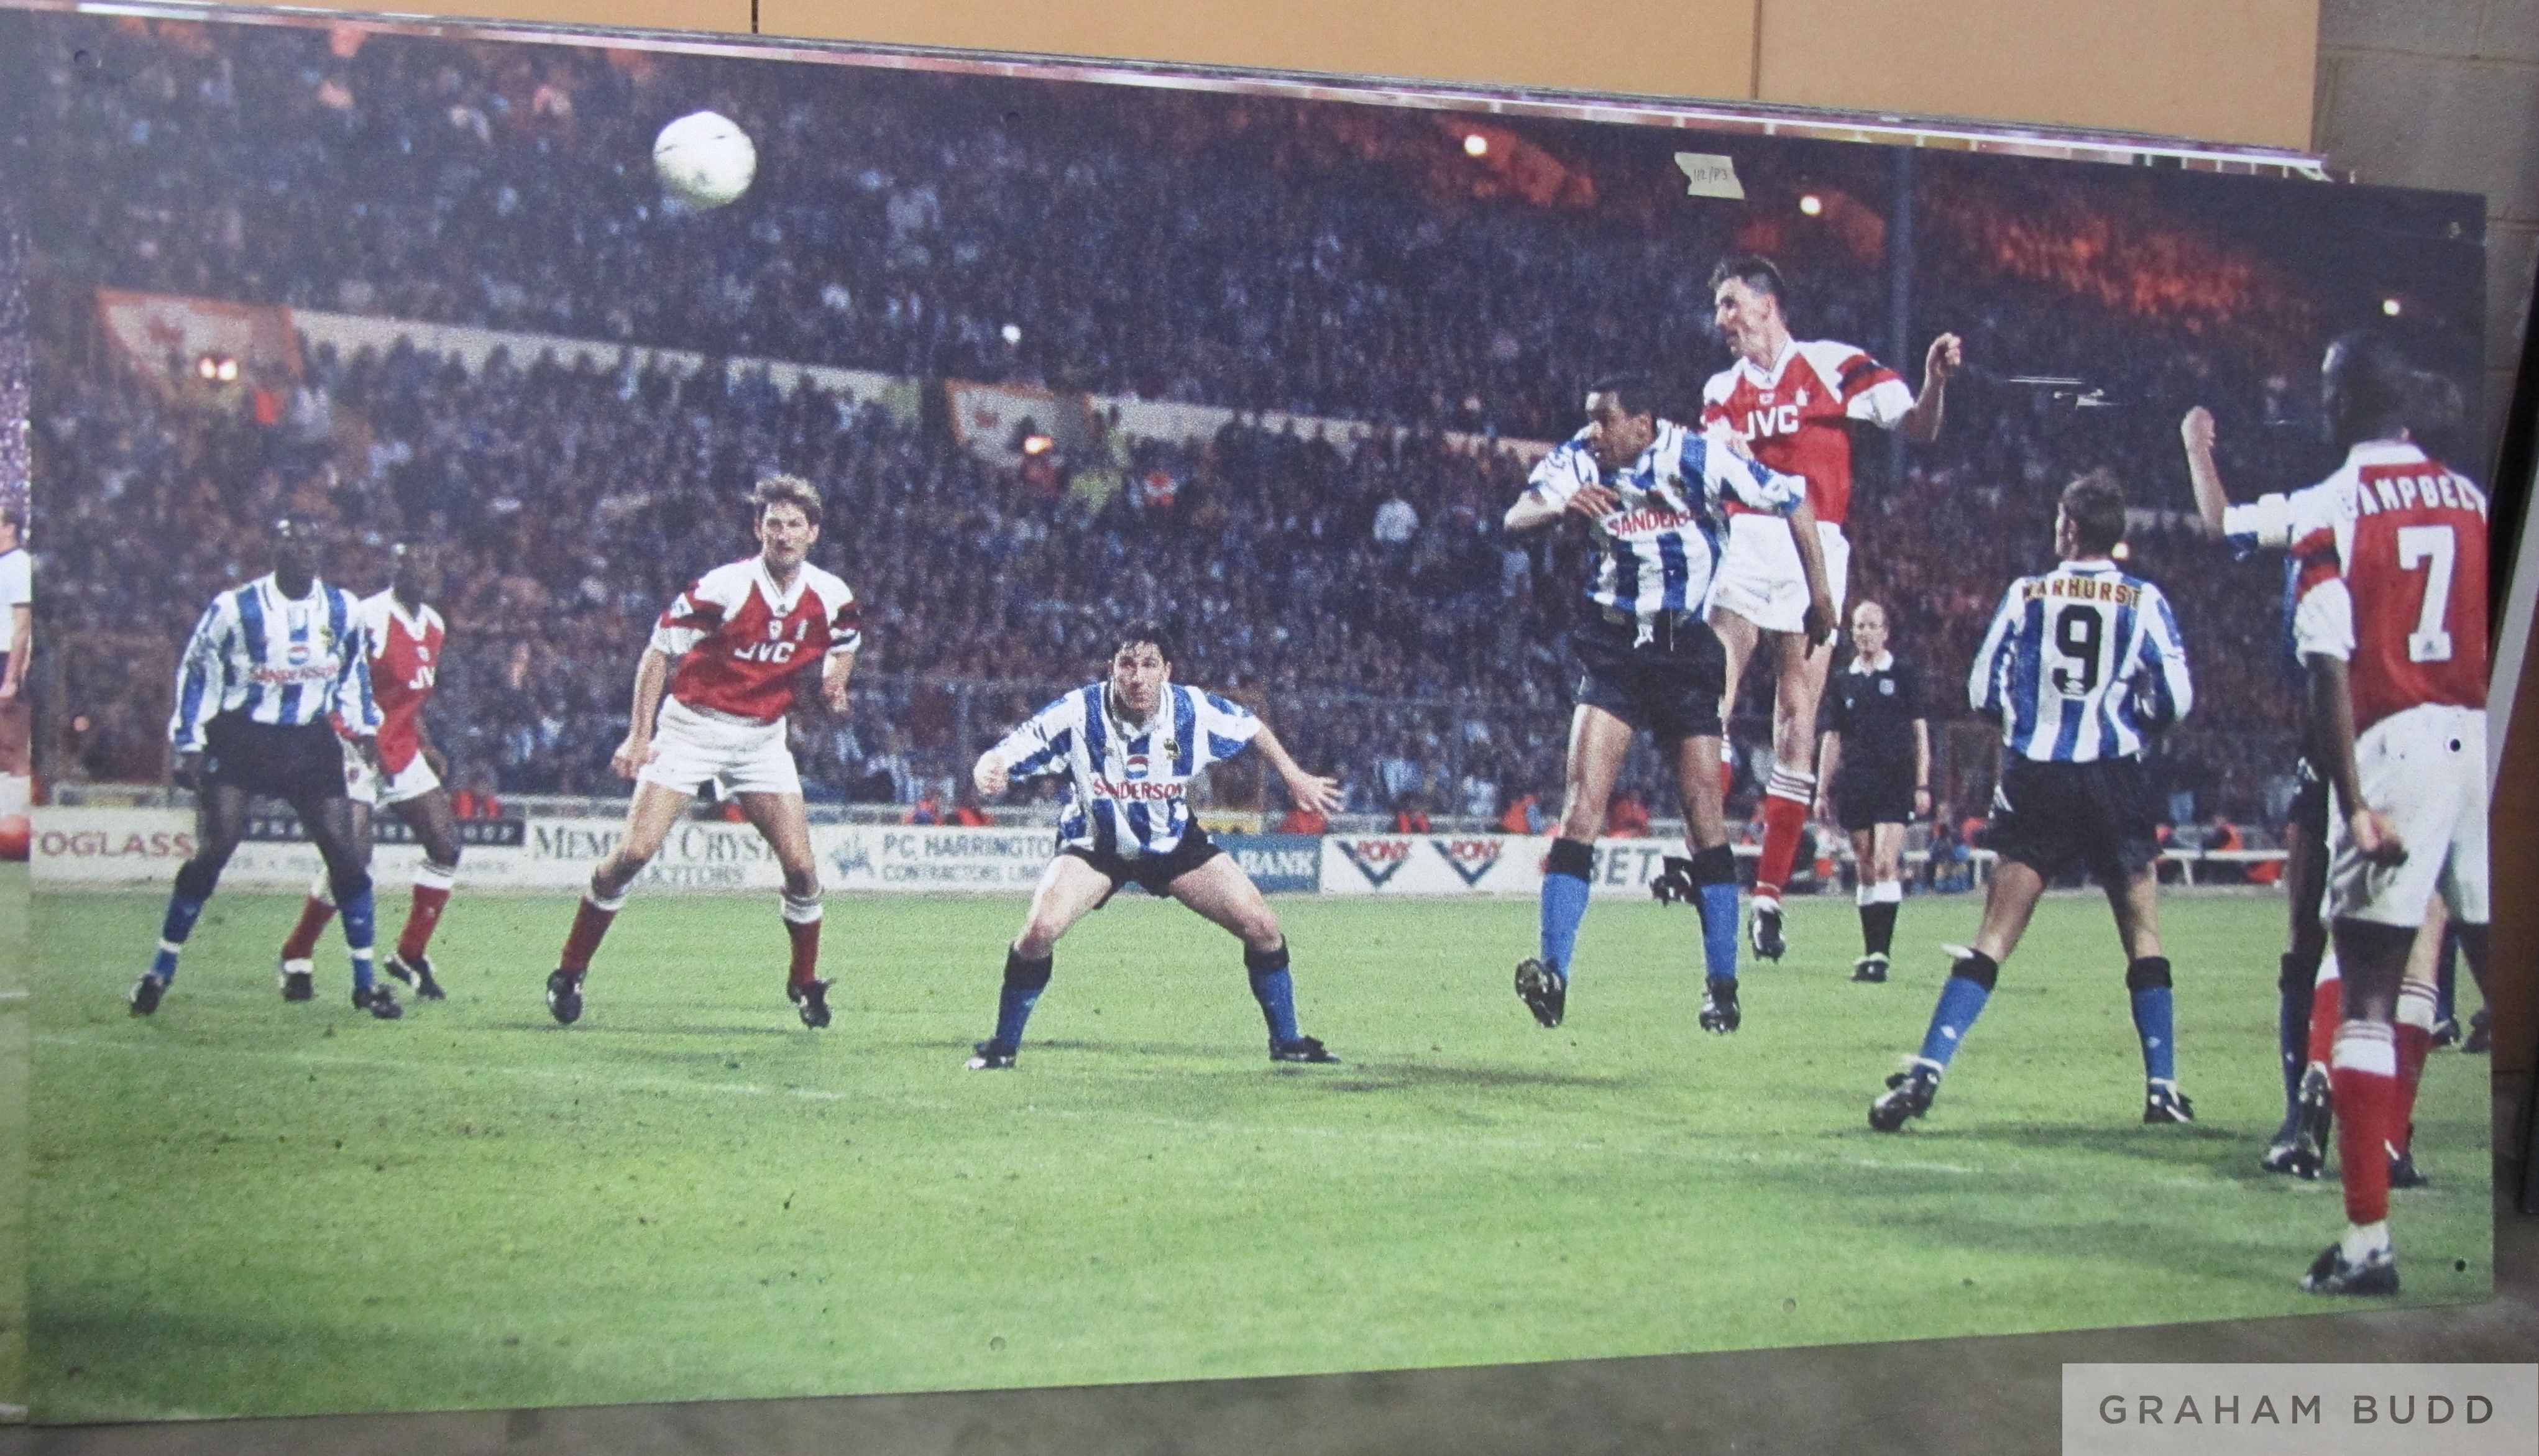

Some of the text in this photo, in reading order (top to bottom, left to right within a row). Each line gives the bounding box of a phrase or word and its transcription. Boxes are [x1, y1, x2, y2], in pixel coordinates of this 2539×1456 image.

[1745, 404, 1799, 440] JVC
[2397, 525, 2455, 662] 7
[734, 642, 796, 664] JVC
[2053, 604, 2103, 695] 9
[35, 831, 198, 857] OGLASS
